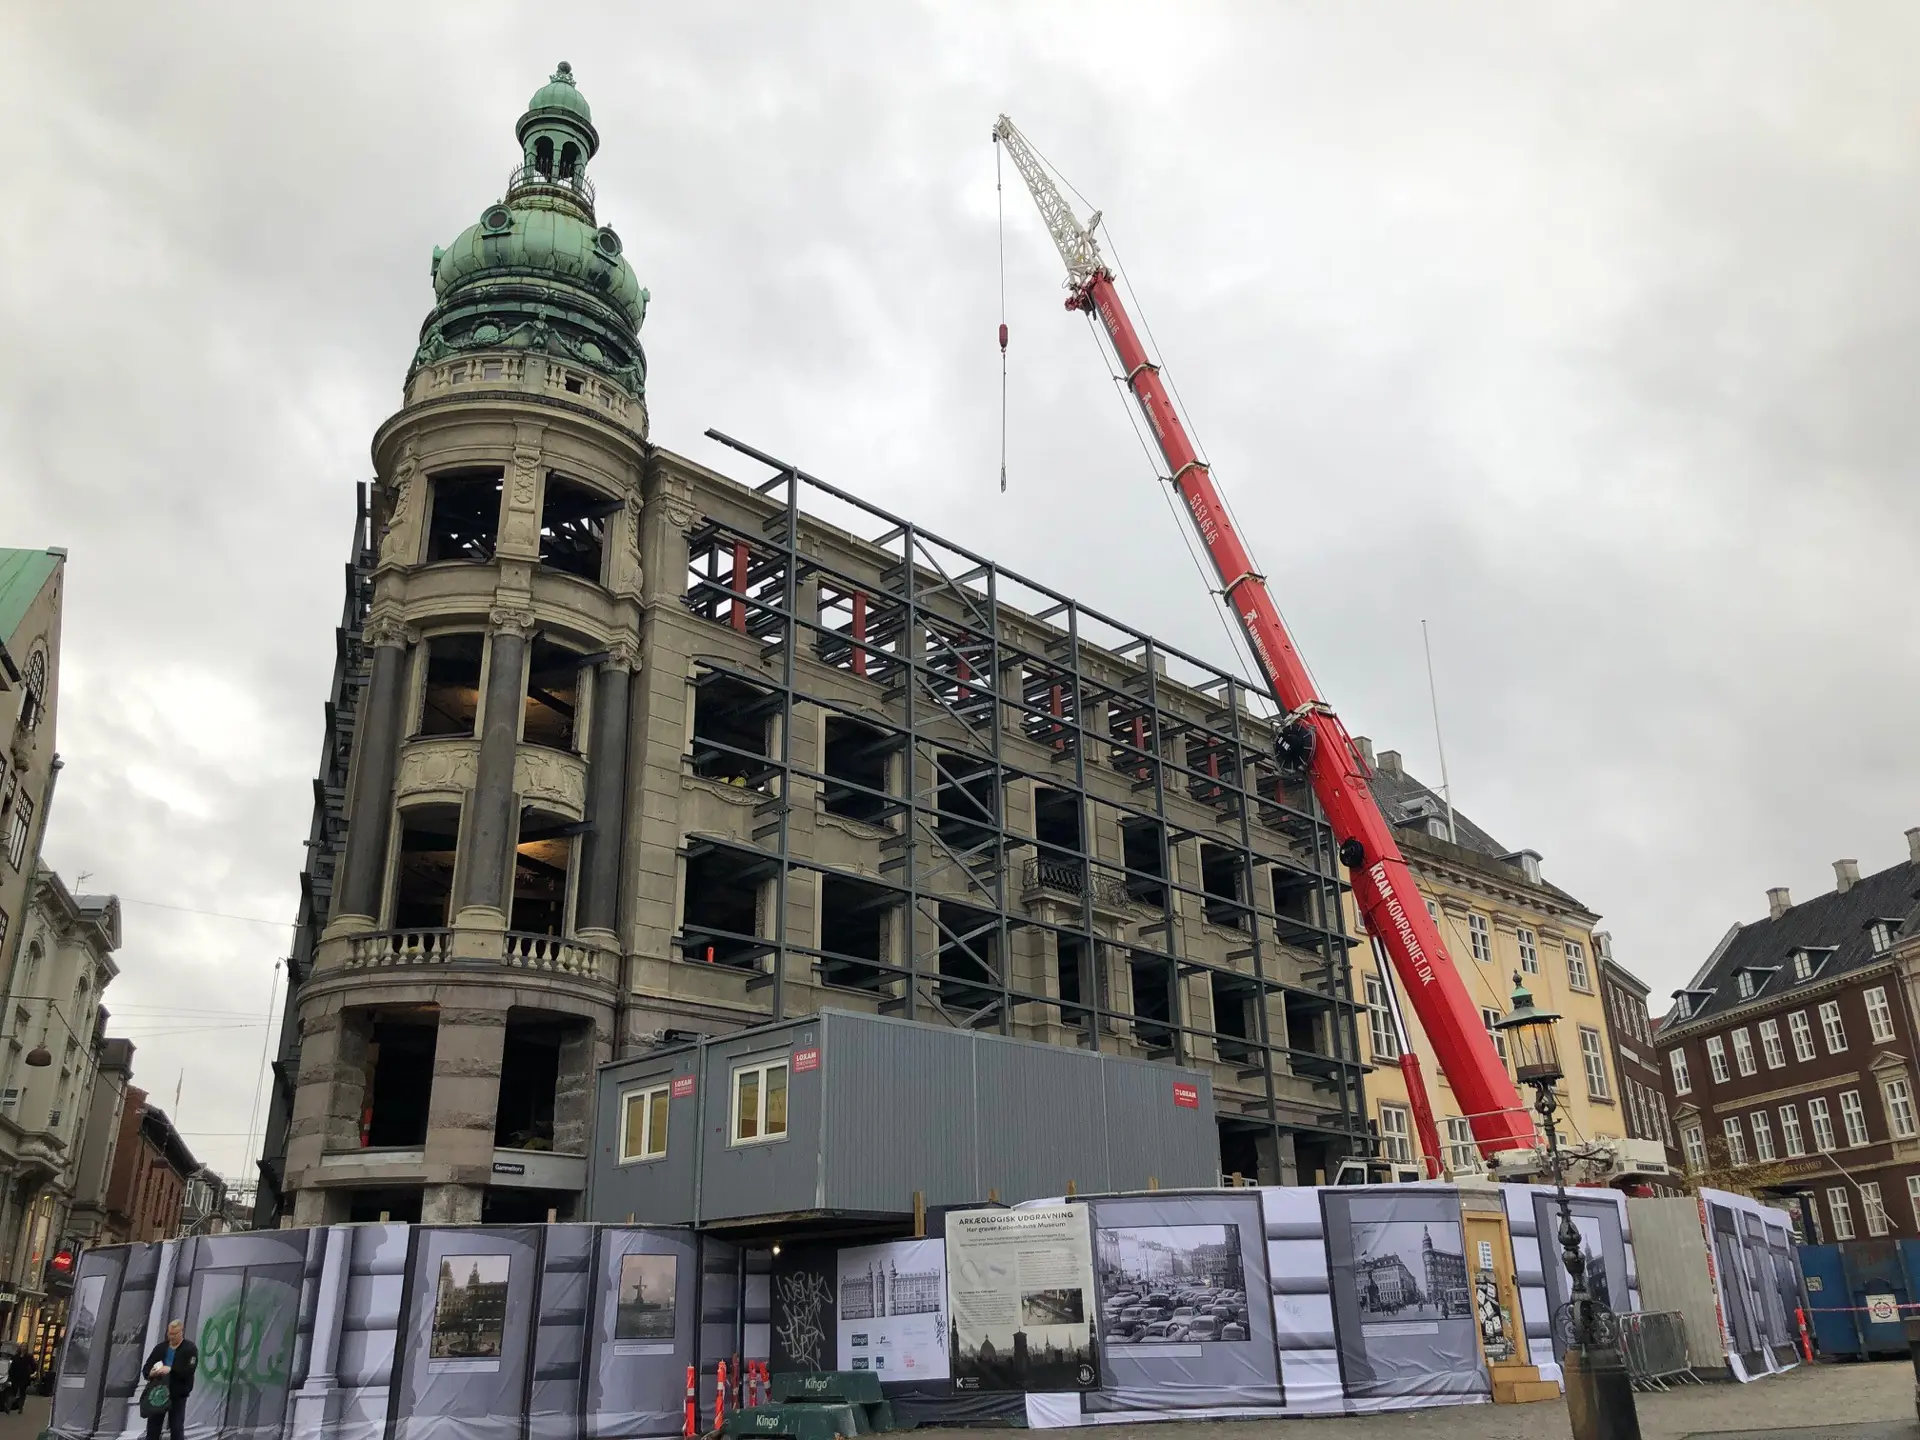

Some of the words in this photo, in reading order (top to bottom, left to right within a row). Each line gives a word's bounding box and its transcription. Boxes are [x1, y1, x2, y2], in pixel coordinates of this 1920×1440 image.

[1190, 493, 1202, 510] 53
[1195, 505, 1208, 521] 53
[1201, 517, 1214, 533] 65
[1206, 529, 1219, 545] 65
[1248, 624, 1280, 682] KRANKOMPAGNIET
[1369, 861, 1436, 986] KRAN-KOMPAGNIET.DK
[796, 1052, 816, 1061] LOXAM
[674, 1079, 692, 1087] LOXAM
[1180, 1090, 1197, 1098] LOXAM
[958, 1216, 1016, 1225] ARKÆOLOGISK
[1017, 1212, 1074, 1222] UDGRAVNING
[998, 1223, 1036, 1231] Københavns
[1037, 1221, 1066, 1229] Museum
[852, 1336, 868, 1345] Kingo
[852, 1359, 868, 1368] Kingo
[805, 1378, 827, 1391] Kingo
[956, 1377, 964, 1389] K
[756, 1415, 779, 1429] Kingo
